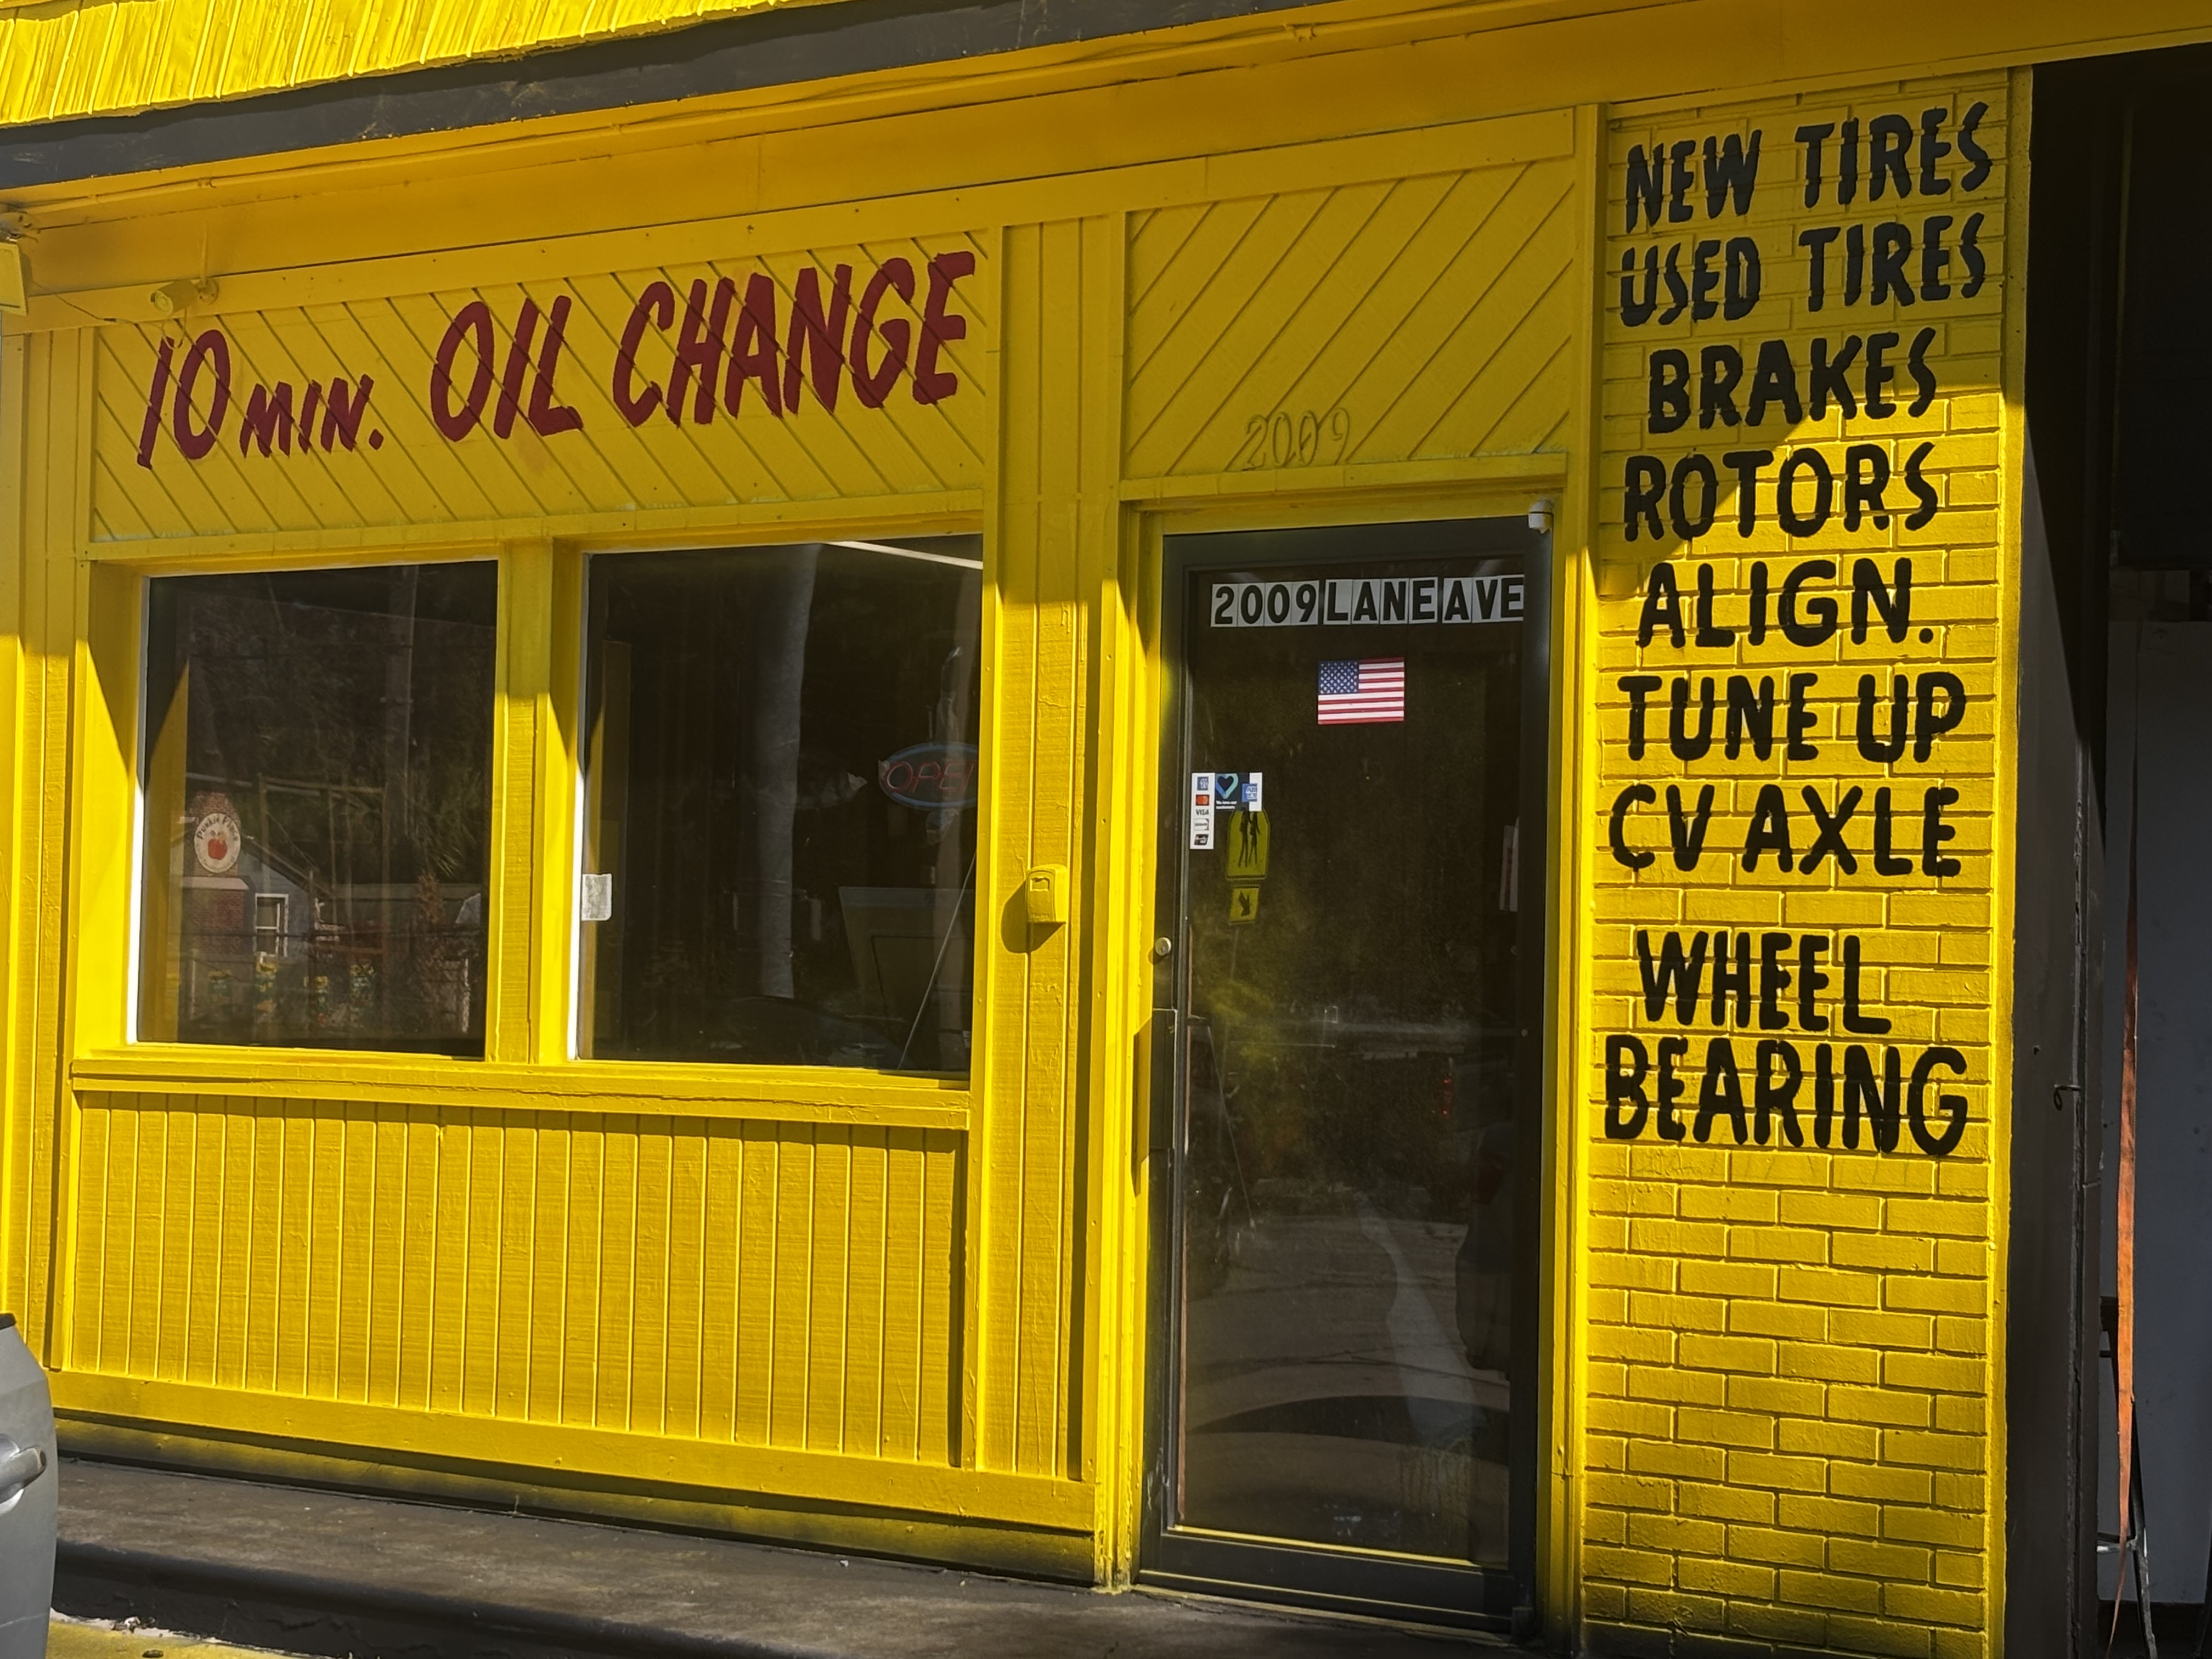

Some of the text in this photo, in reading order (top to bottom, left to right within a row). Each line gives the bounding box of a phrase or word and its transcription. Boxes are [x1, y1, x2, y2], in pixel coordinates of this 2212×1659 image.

[1626, 101, 1993, 234] NEW TIRES
[1620, 212, 1985, 327] USED TIRES
[137, 329, 231, 470] 10
[430, 295, 584, 442] OIL
[612, 250, 976, 428] CHANGE
[1647, 327, 1937, 434] BRAKES
[1241, 407, 1351, 472] 2009
[1623, 441, 1939, 541] ROTORS
[1214, 576, 1524, 625] 2009 LANE AVE
[1635, 557, 1934, 648] ALIGN.
[1617, 672, 1966, 764] TUNE UP
[1609, 783, 1962, 877] CV AXLE
[1636, 929, 1892, 1034] WHEEL
[1604, 1035, 1968, 1155] BEARING
